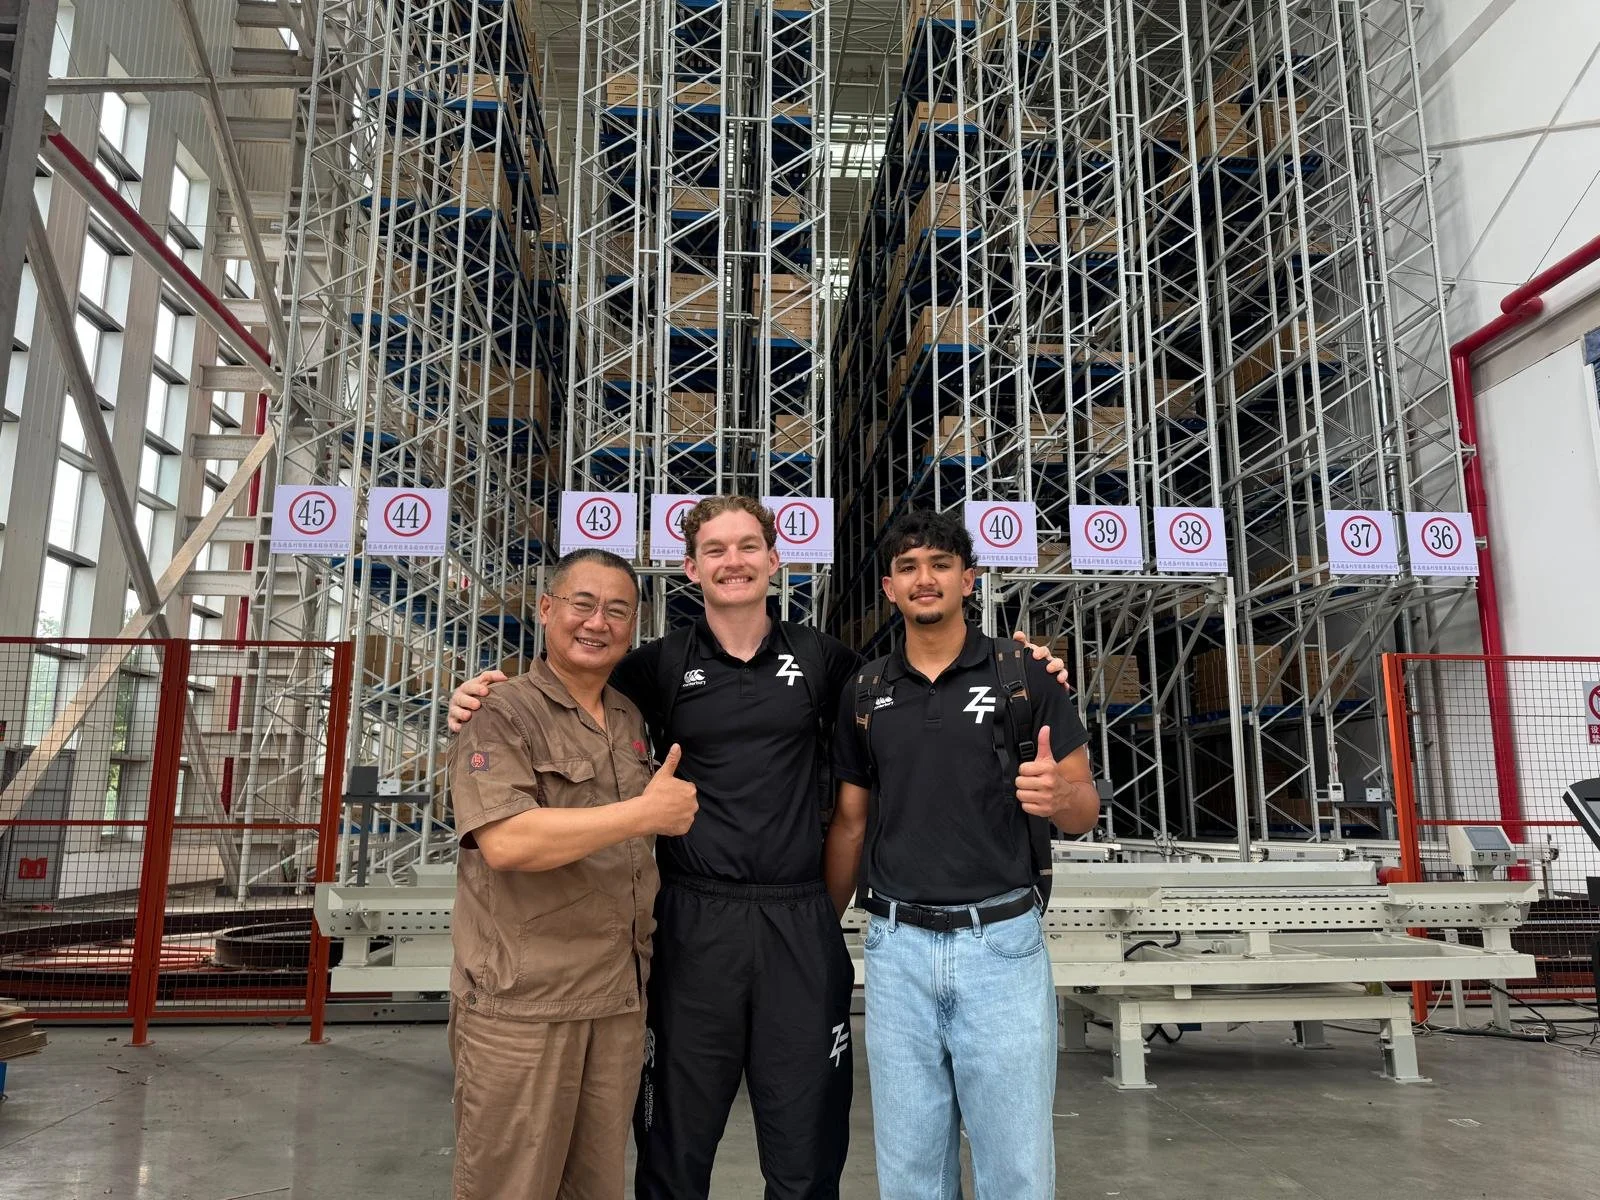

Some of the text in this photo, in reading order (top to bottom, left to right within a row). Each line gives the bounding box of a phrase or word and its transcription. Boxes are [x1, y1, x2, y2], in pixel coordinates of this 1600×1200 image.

[298, 499, 326, 527] 45
[392, 502, 420, 529] 44
[585, 505, 612, 532] 43
[784, 510, 808, 536] 41
[989, 515, 1014, 540] 40
[1094, 518, 1118, 544] 39
[1178, 520, 1203, 546] 38
[1349, 523, 1371, 549] 37
[1429, 525, 1454, 550] 36
